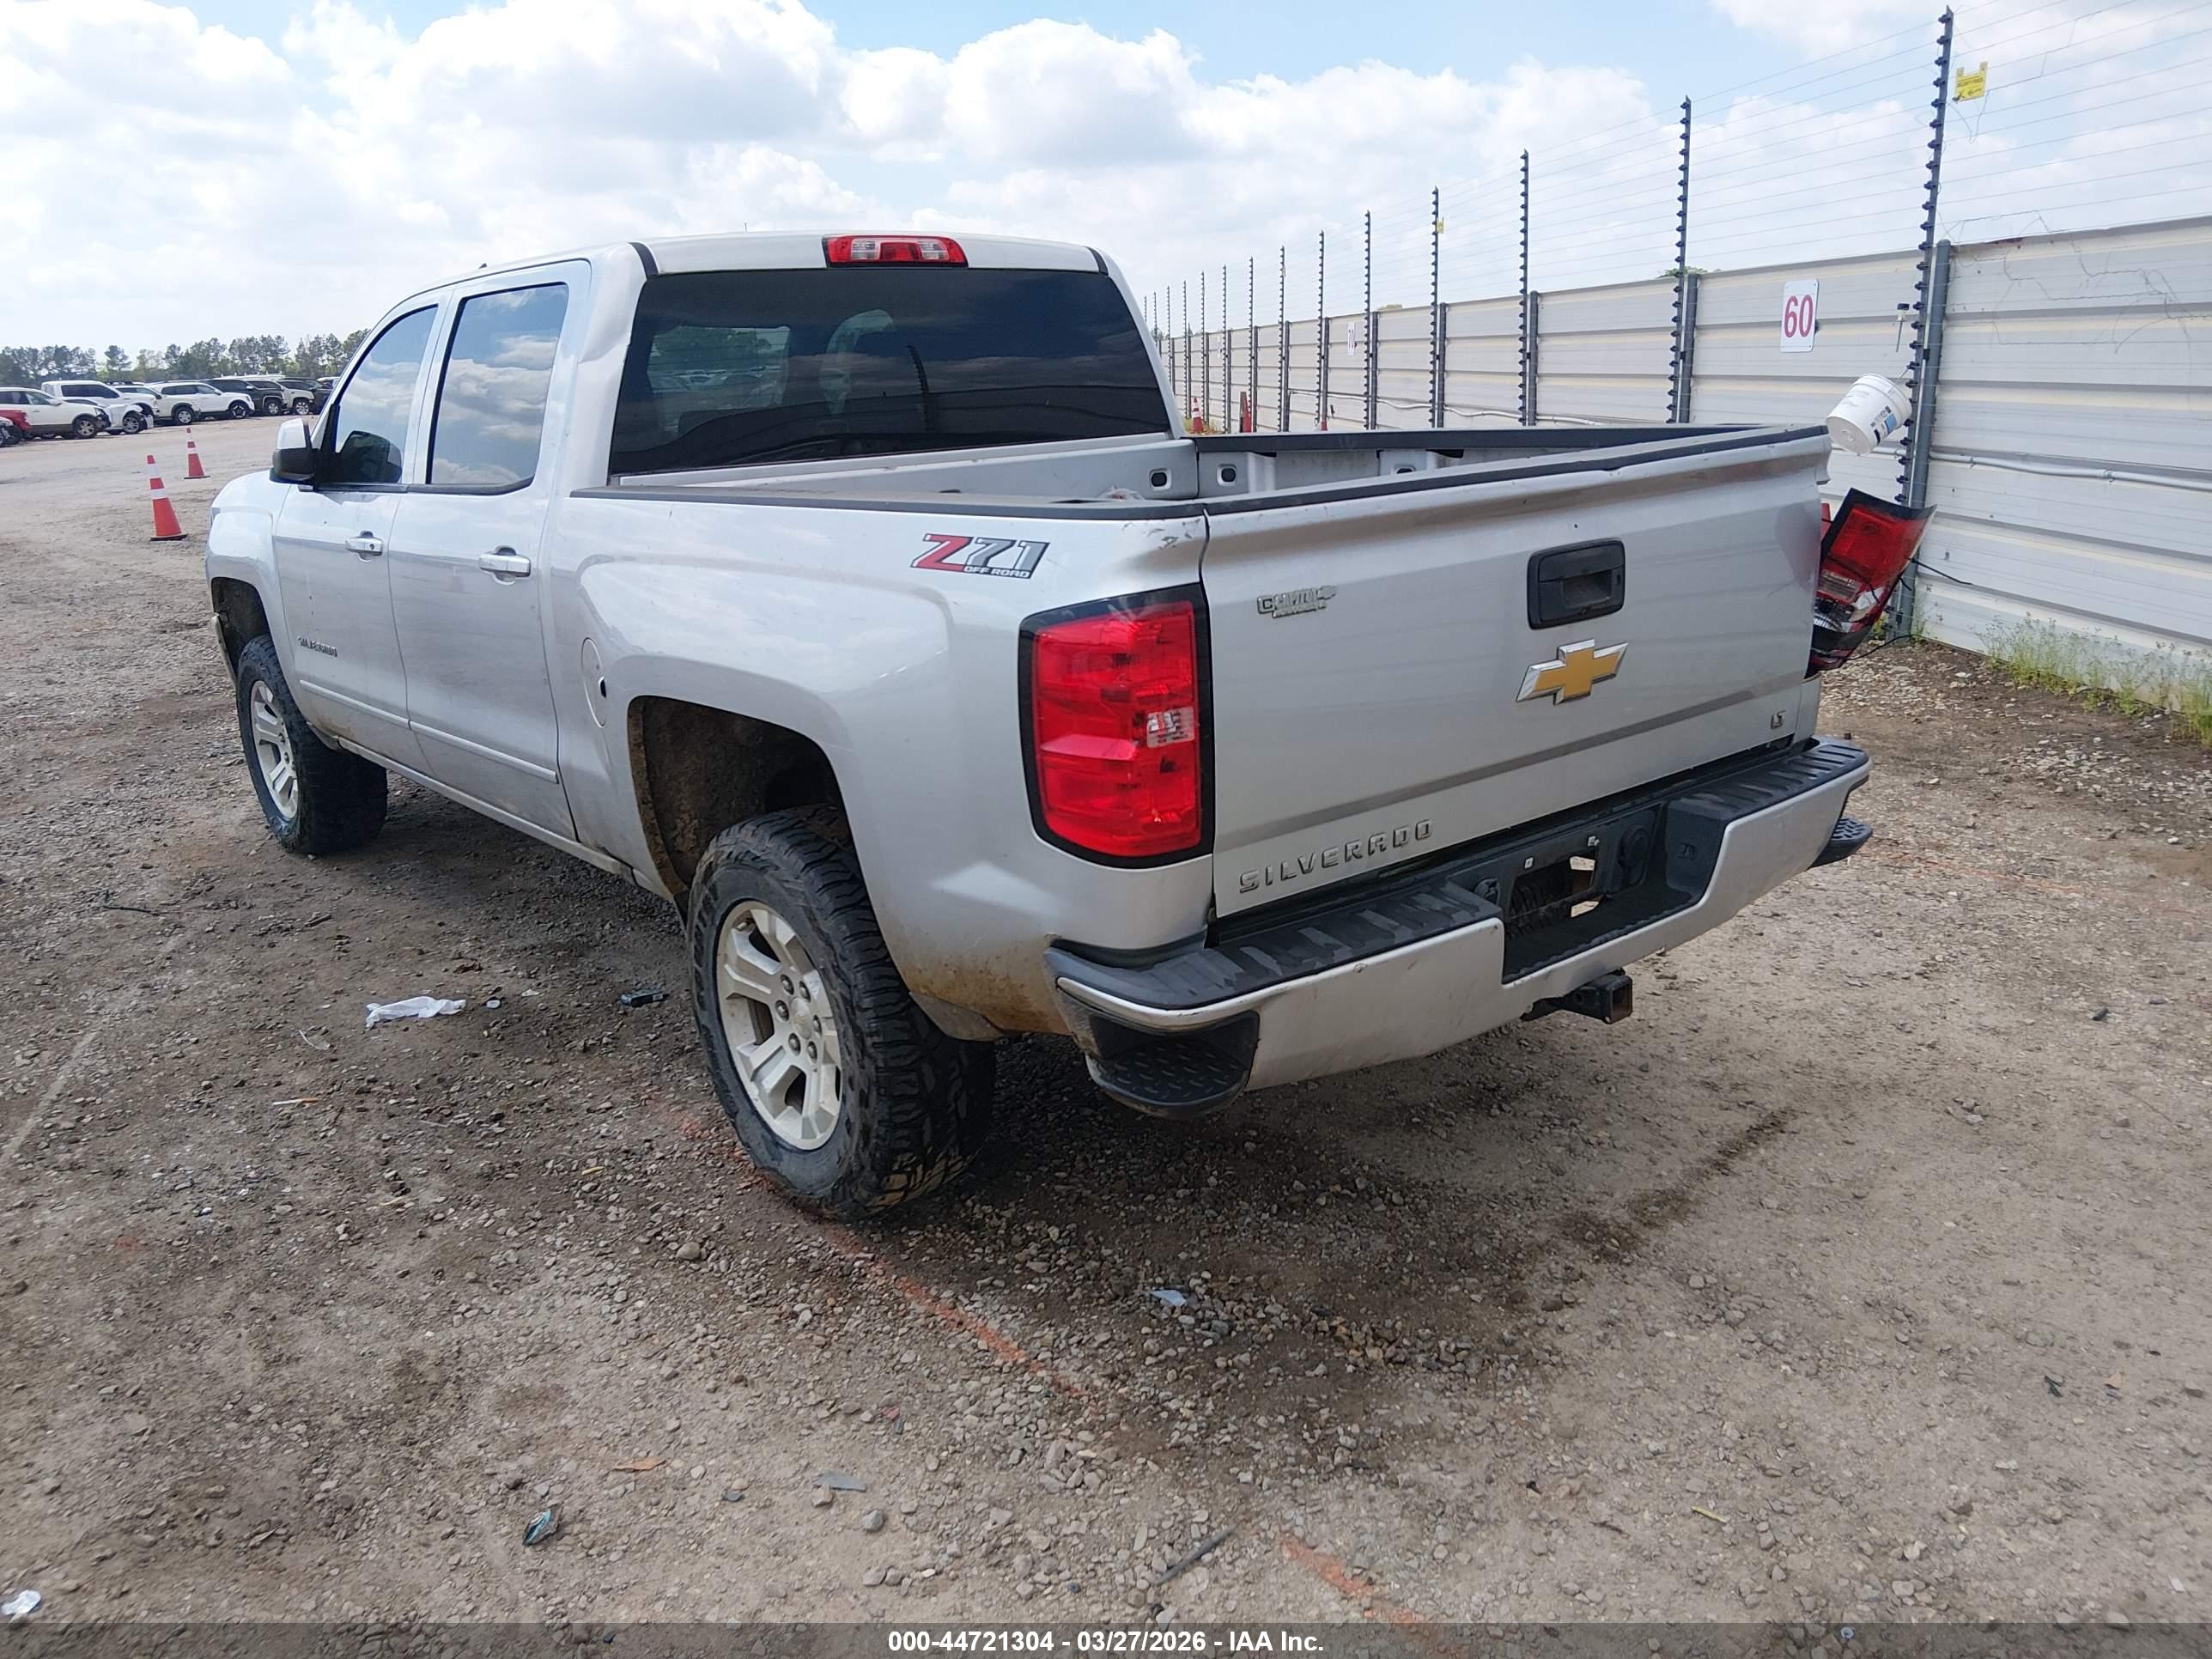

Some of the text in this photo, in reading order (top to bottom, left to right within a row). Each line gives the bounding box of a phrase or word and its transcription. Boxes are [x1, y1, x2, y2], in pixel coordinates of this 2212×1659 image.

[1784, 295, 1814, 338] 60
[910, 533, 1050, 576] Z71
[963, 565, 1031, 579] OFF ROAD
[1239, 818, 1433, 894] SILVERADO
